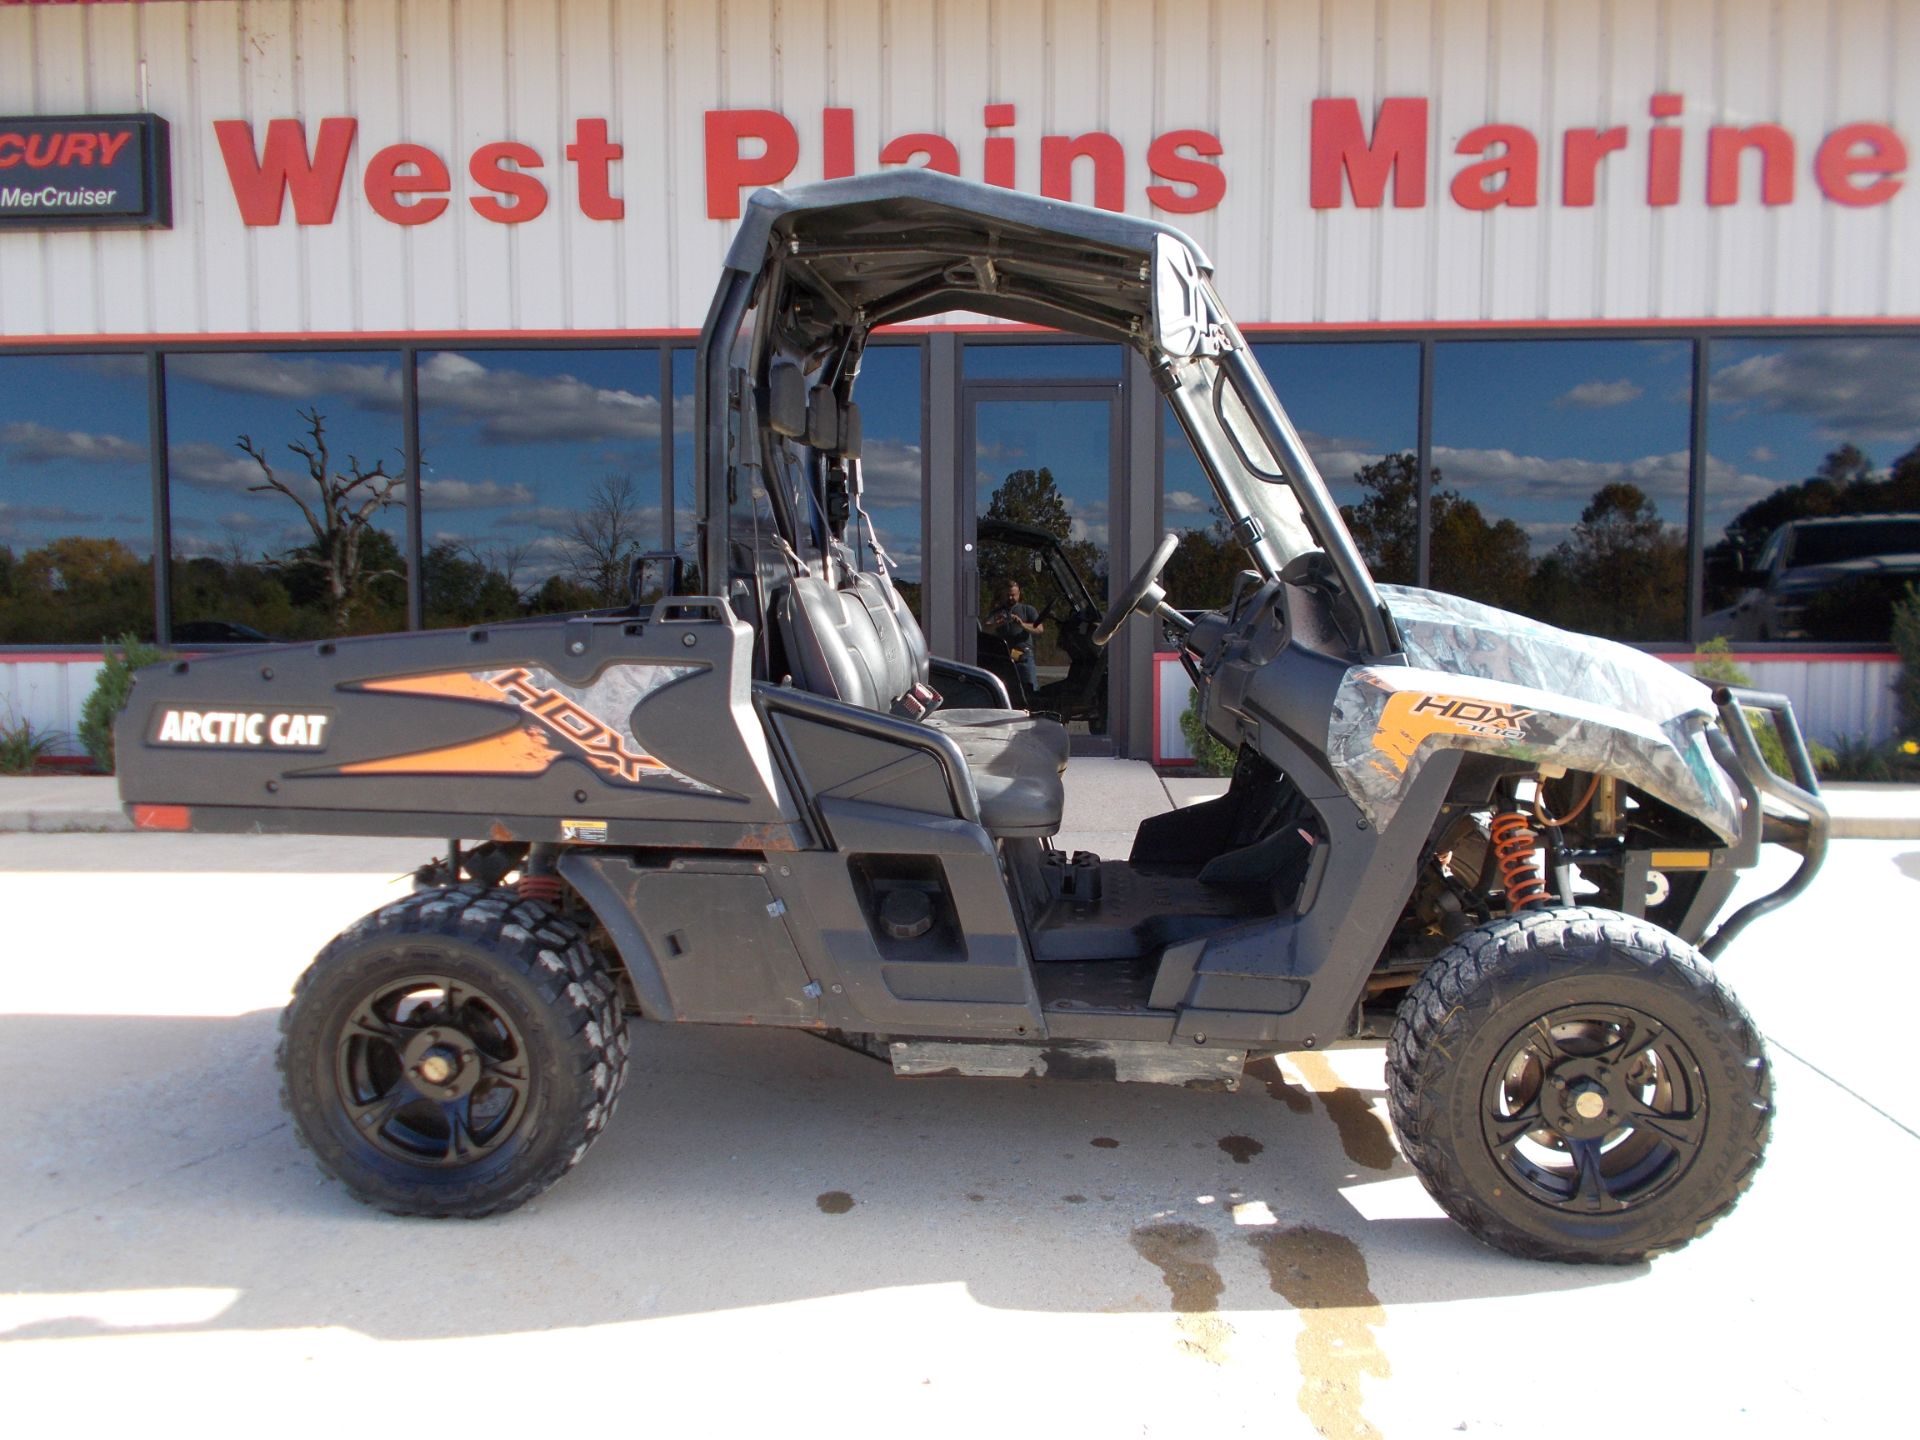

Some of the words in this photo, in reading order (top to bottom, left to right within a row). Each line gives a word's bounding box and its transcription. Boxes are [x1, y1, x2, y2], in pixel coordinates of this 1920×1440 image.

[213, 117, 625, 226] West
[1310, 94, 1908, 209] Marine
[0, 186, 116, 207] MerCruiser
[158, 710, 266, 744] ARCTIC
[269, 713, 328, 746] CAT
[488, 667, 670, 782] HDX
[1410, 694, 1537, 730] HDX
